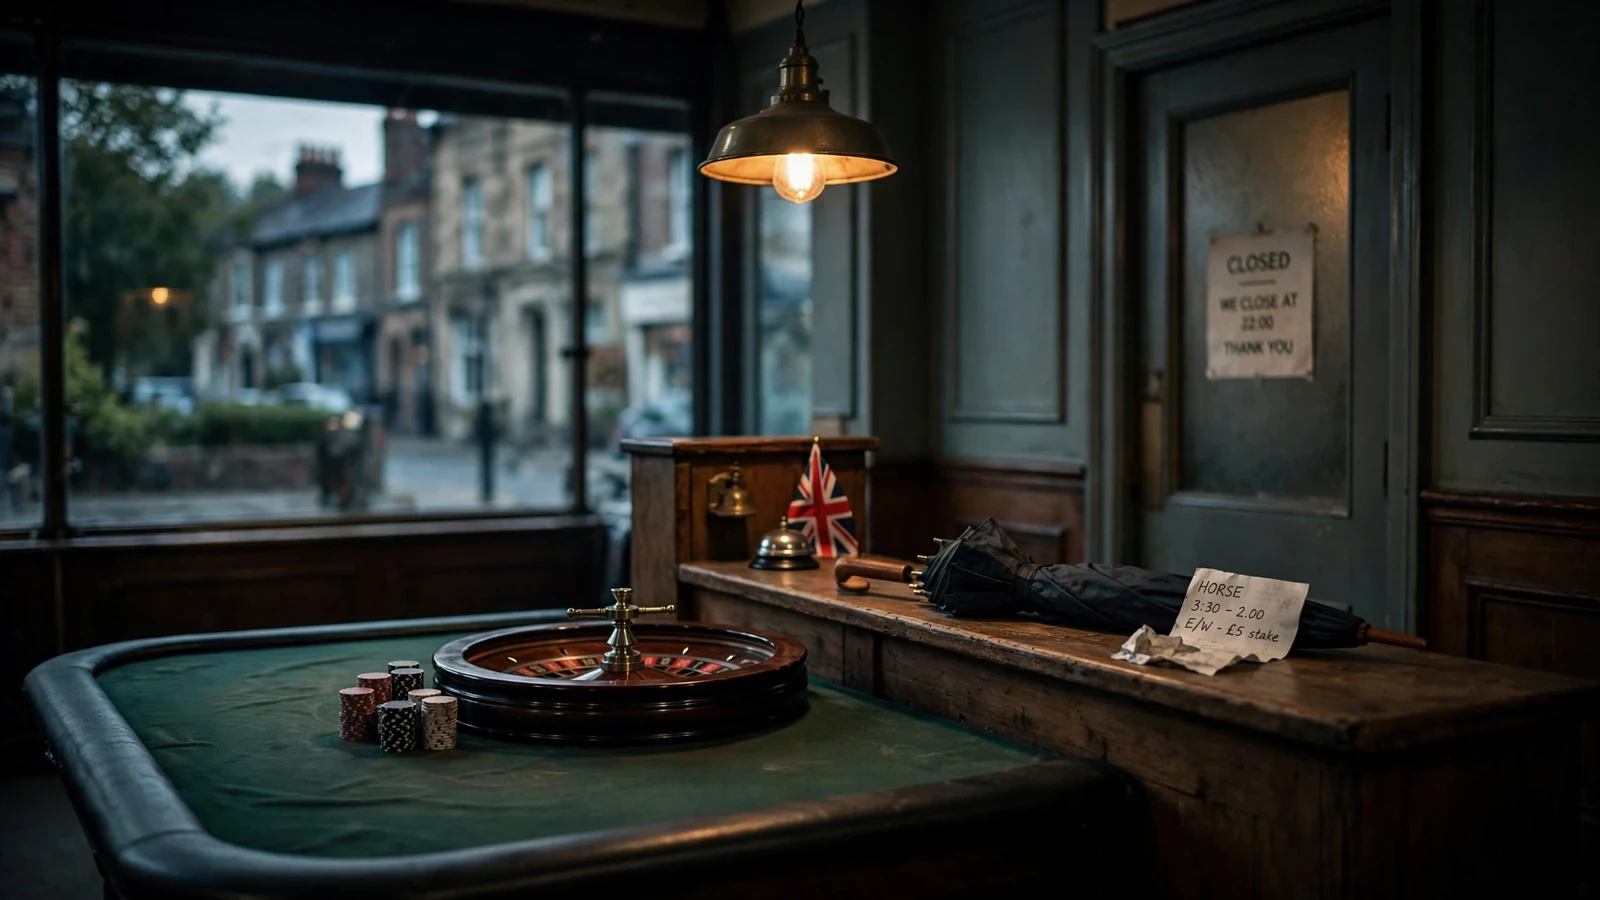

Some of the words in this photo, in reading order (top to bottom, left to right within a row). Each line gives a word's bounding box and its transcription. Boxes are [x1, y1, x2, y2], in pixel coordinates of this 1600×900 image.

[1226, 251, 1291, 274] CLOSED
[1218, 297, 1237, 311] WE
[1240, 295, 1278, 311] CLOSE
[1282, 292, 1298, 308] AT
[1224, 340, 1263, 356] THANK
[1268, 339, 1294, 355] YOU
[1198, 581, 1244, 598] HORSE
[1191, 600, 1220, 613] 3:30
[1236, 607, 1265, 620] 2.00
[1184, 617, 1214, 632] E/W
[1226, 624, 1245, 637] £5
[1248, 629, 1279, 643] stake
